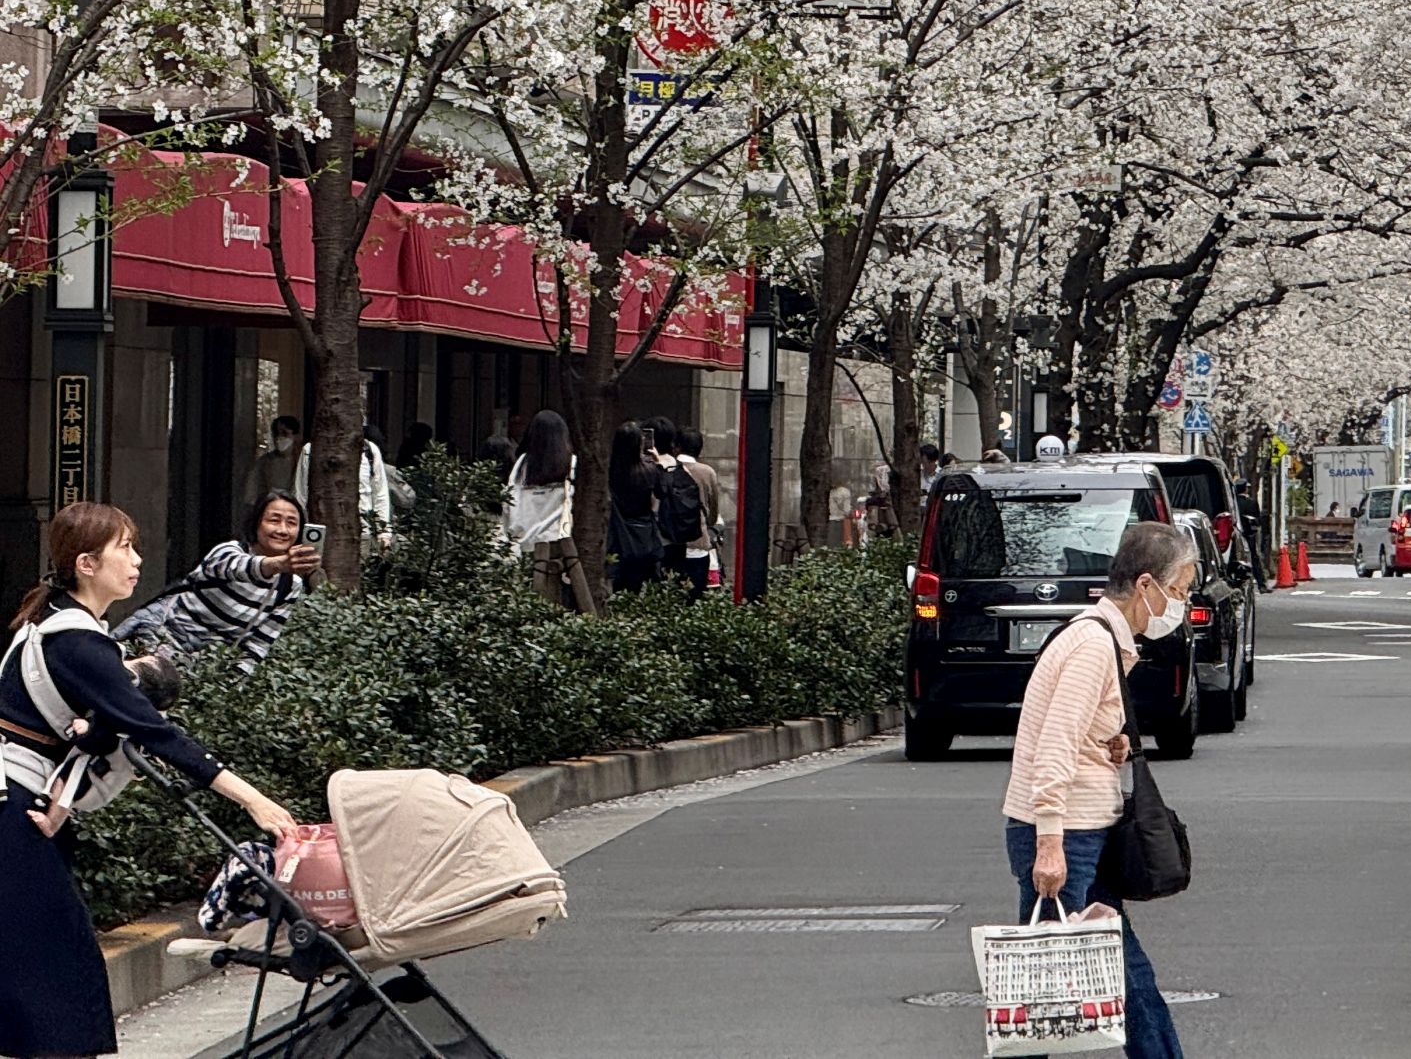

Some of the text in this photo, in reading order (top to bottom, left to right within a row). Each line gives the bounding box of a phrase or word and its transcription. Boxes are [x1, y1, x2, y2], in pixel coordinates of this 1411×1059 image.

[62, 383, 82, 505] 日本橋二丁目
[1328, 468, 1375, 477] SAGAWA
